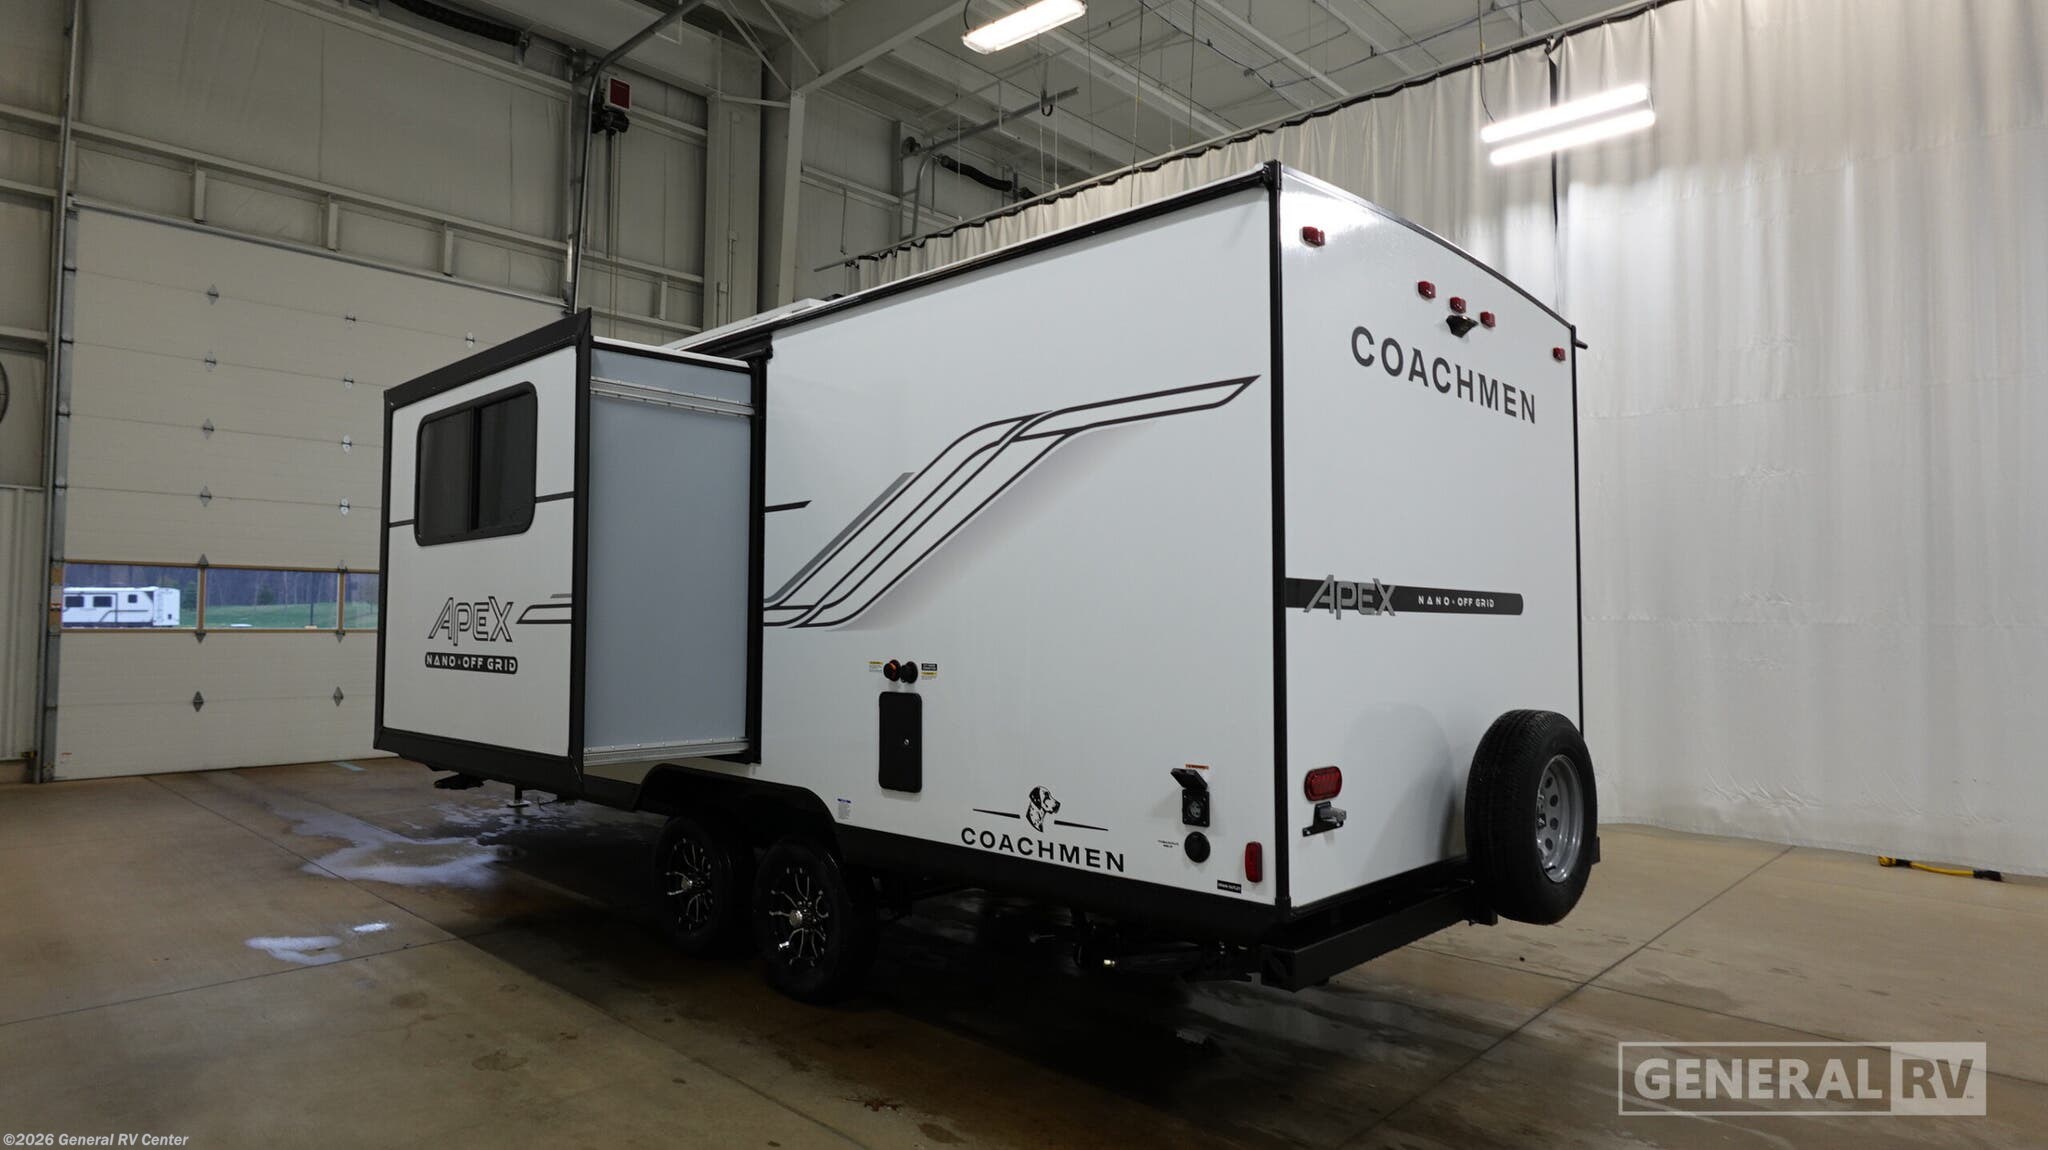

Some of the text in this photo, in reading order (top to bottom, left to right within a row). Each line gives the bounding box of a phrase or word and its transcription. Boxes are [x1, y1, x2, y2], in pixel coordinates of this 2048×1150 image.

[1351, 325, 1536, 425] COACHMEN
[1303, 574, 1396, 620] APEX
[1475, 597, 1495, 608] GRID
[428, 595, 514, 647] APEX
[486, 657, 517, 672] GRID
[961, 827, 1124, 873] COACHMEN
